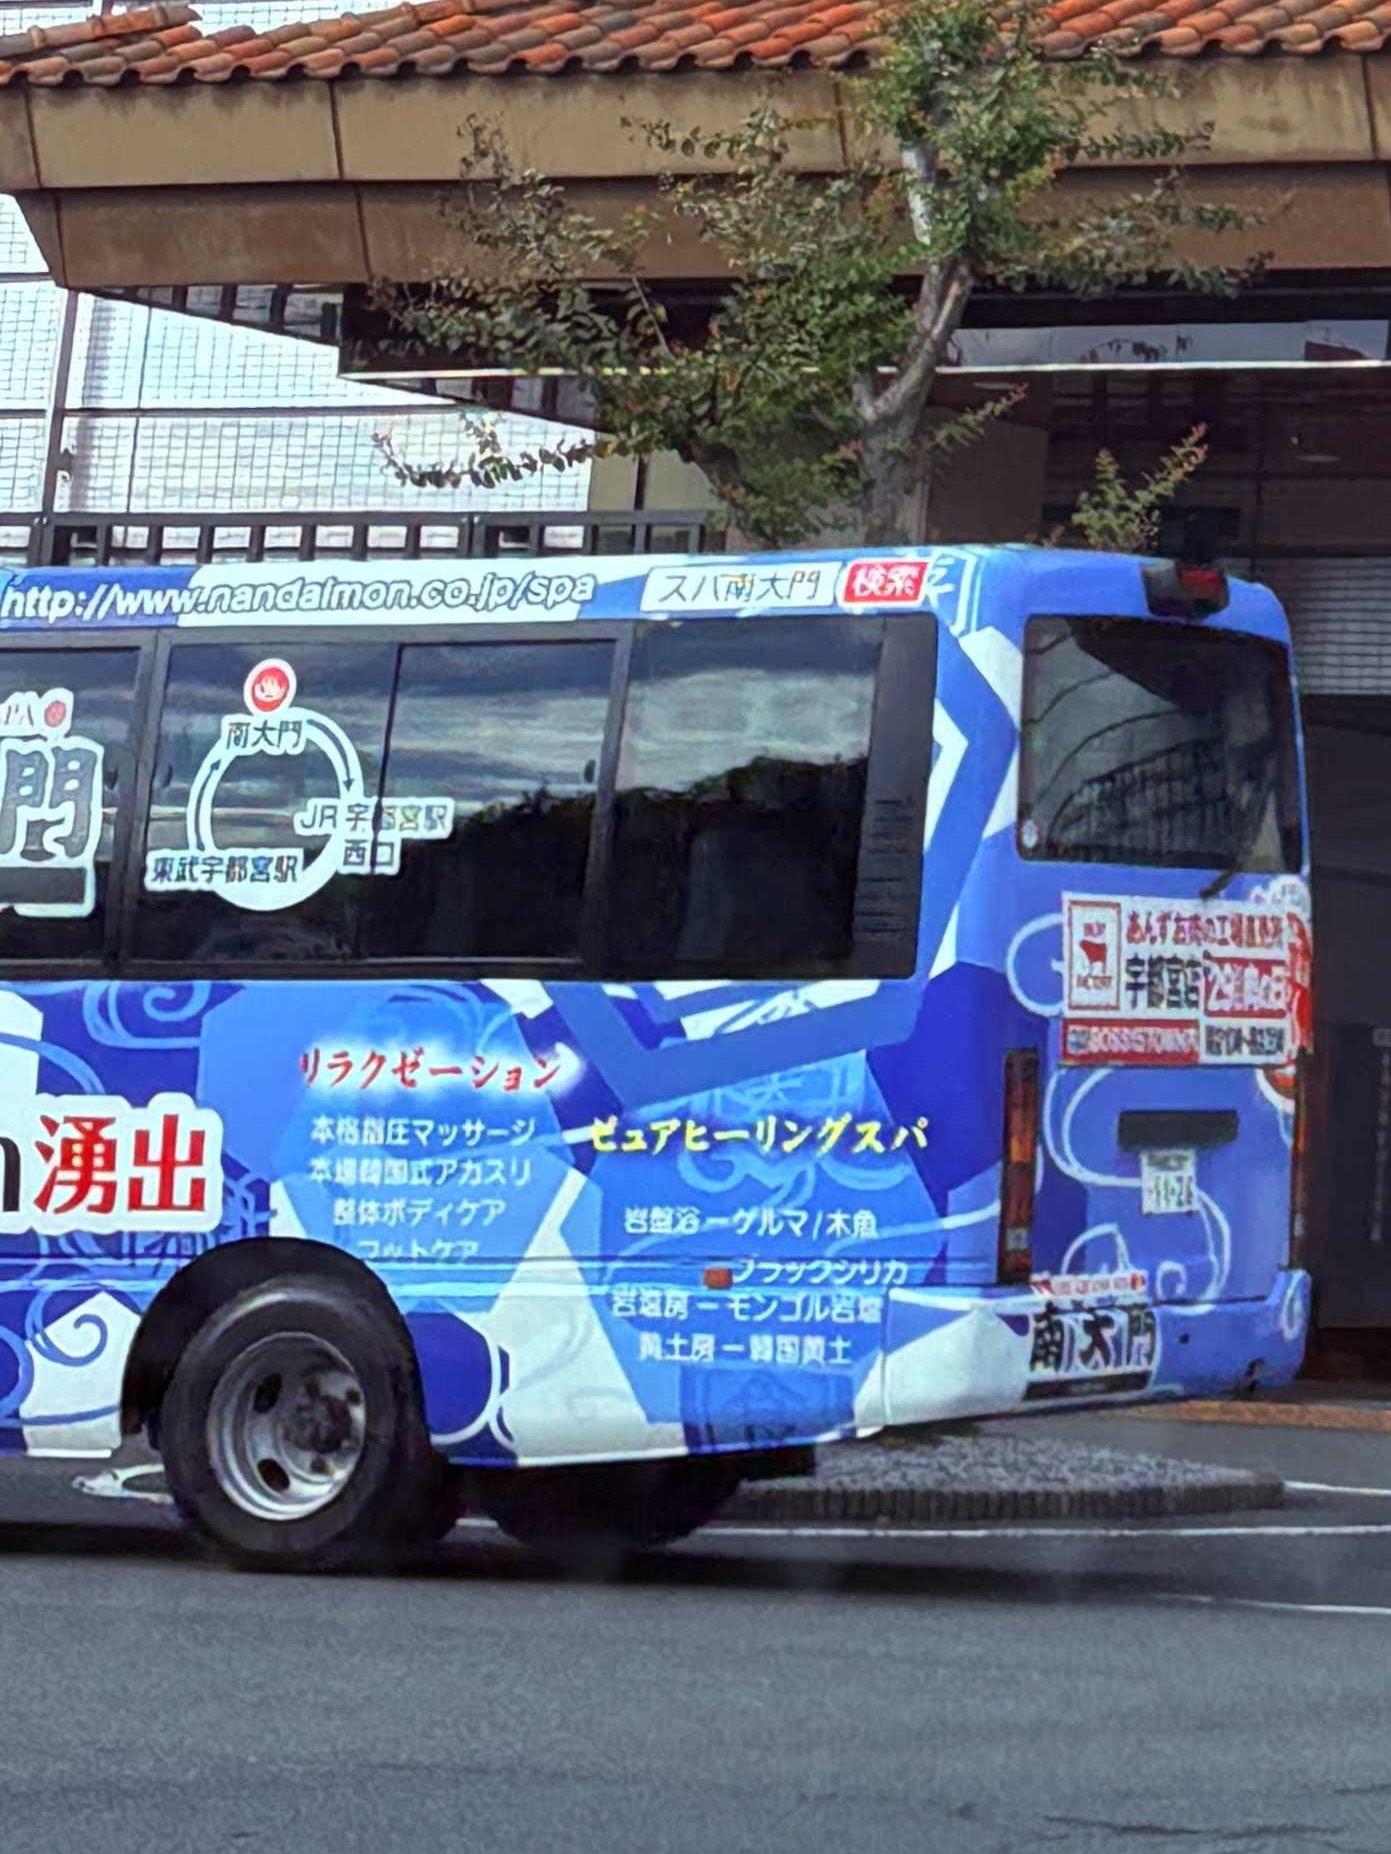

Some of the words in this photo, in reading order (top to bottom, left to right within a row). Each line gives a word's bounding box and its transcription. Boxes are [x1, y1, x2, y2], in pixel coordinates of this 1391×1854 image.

[300, 1047, 561, 1092] リラクゼーション
[592, 1113, 928, 1156] ピュアヒーリングスパ
